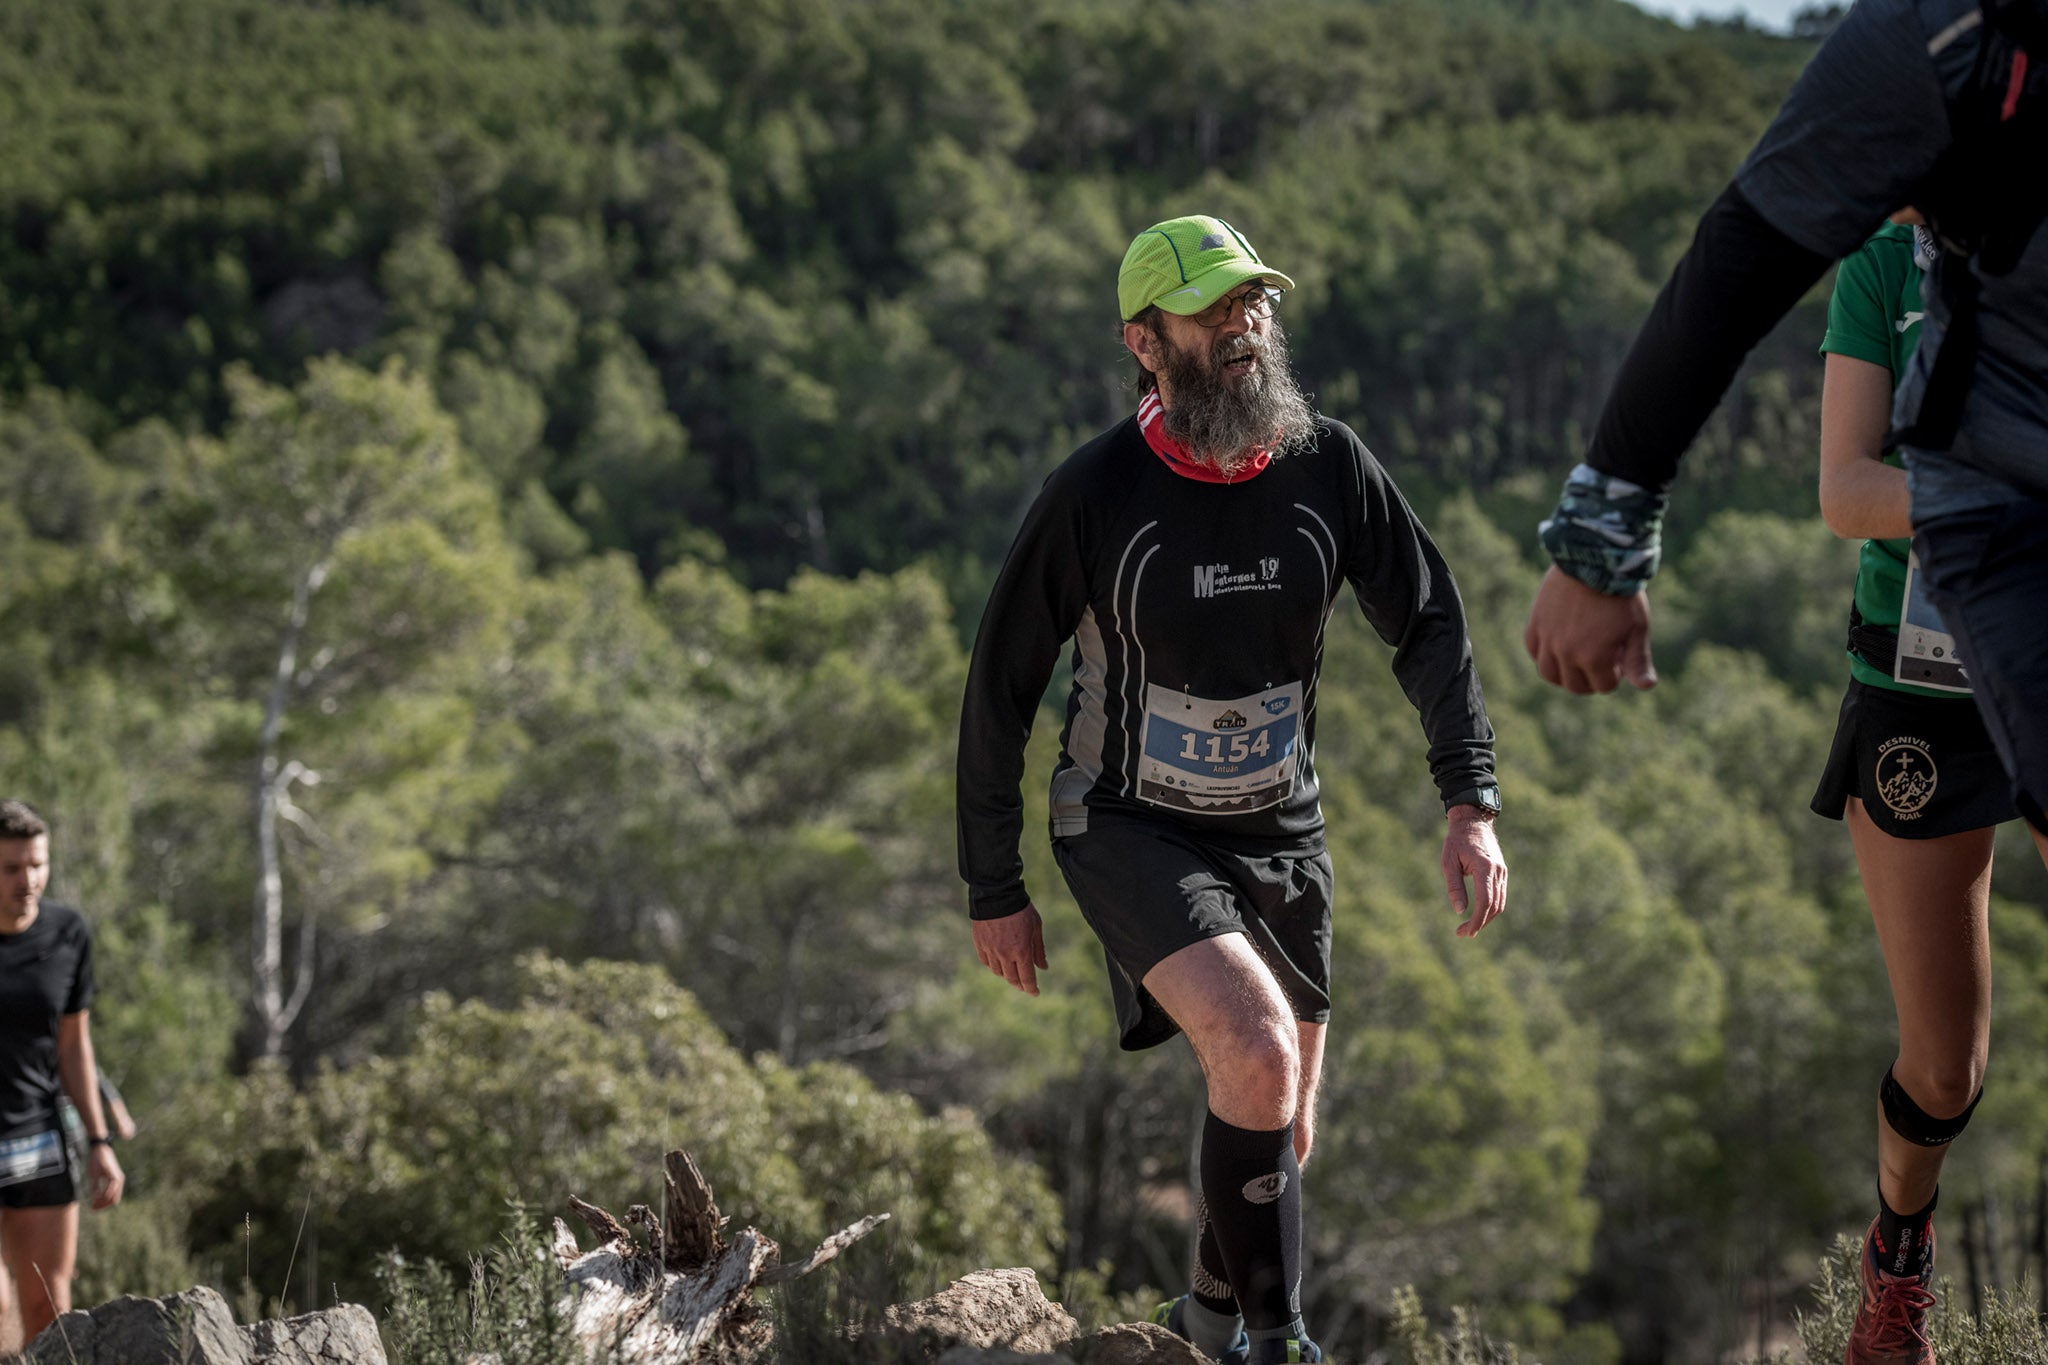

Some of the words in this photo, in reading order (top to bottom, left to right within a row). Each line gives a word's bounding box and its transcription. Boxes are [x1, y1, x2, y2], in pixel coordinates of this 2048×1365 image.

[1215, 717, 1245, 728] TRAIL
[1179, 729, 1270, 763] 1154
[1878, 736, 1931, 753] DESNIVEL
[1894, 811, 1923, 820] TRAIL
